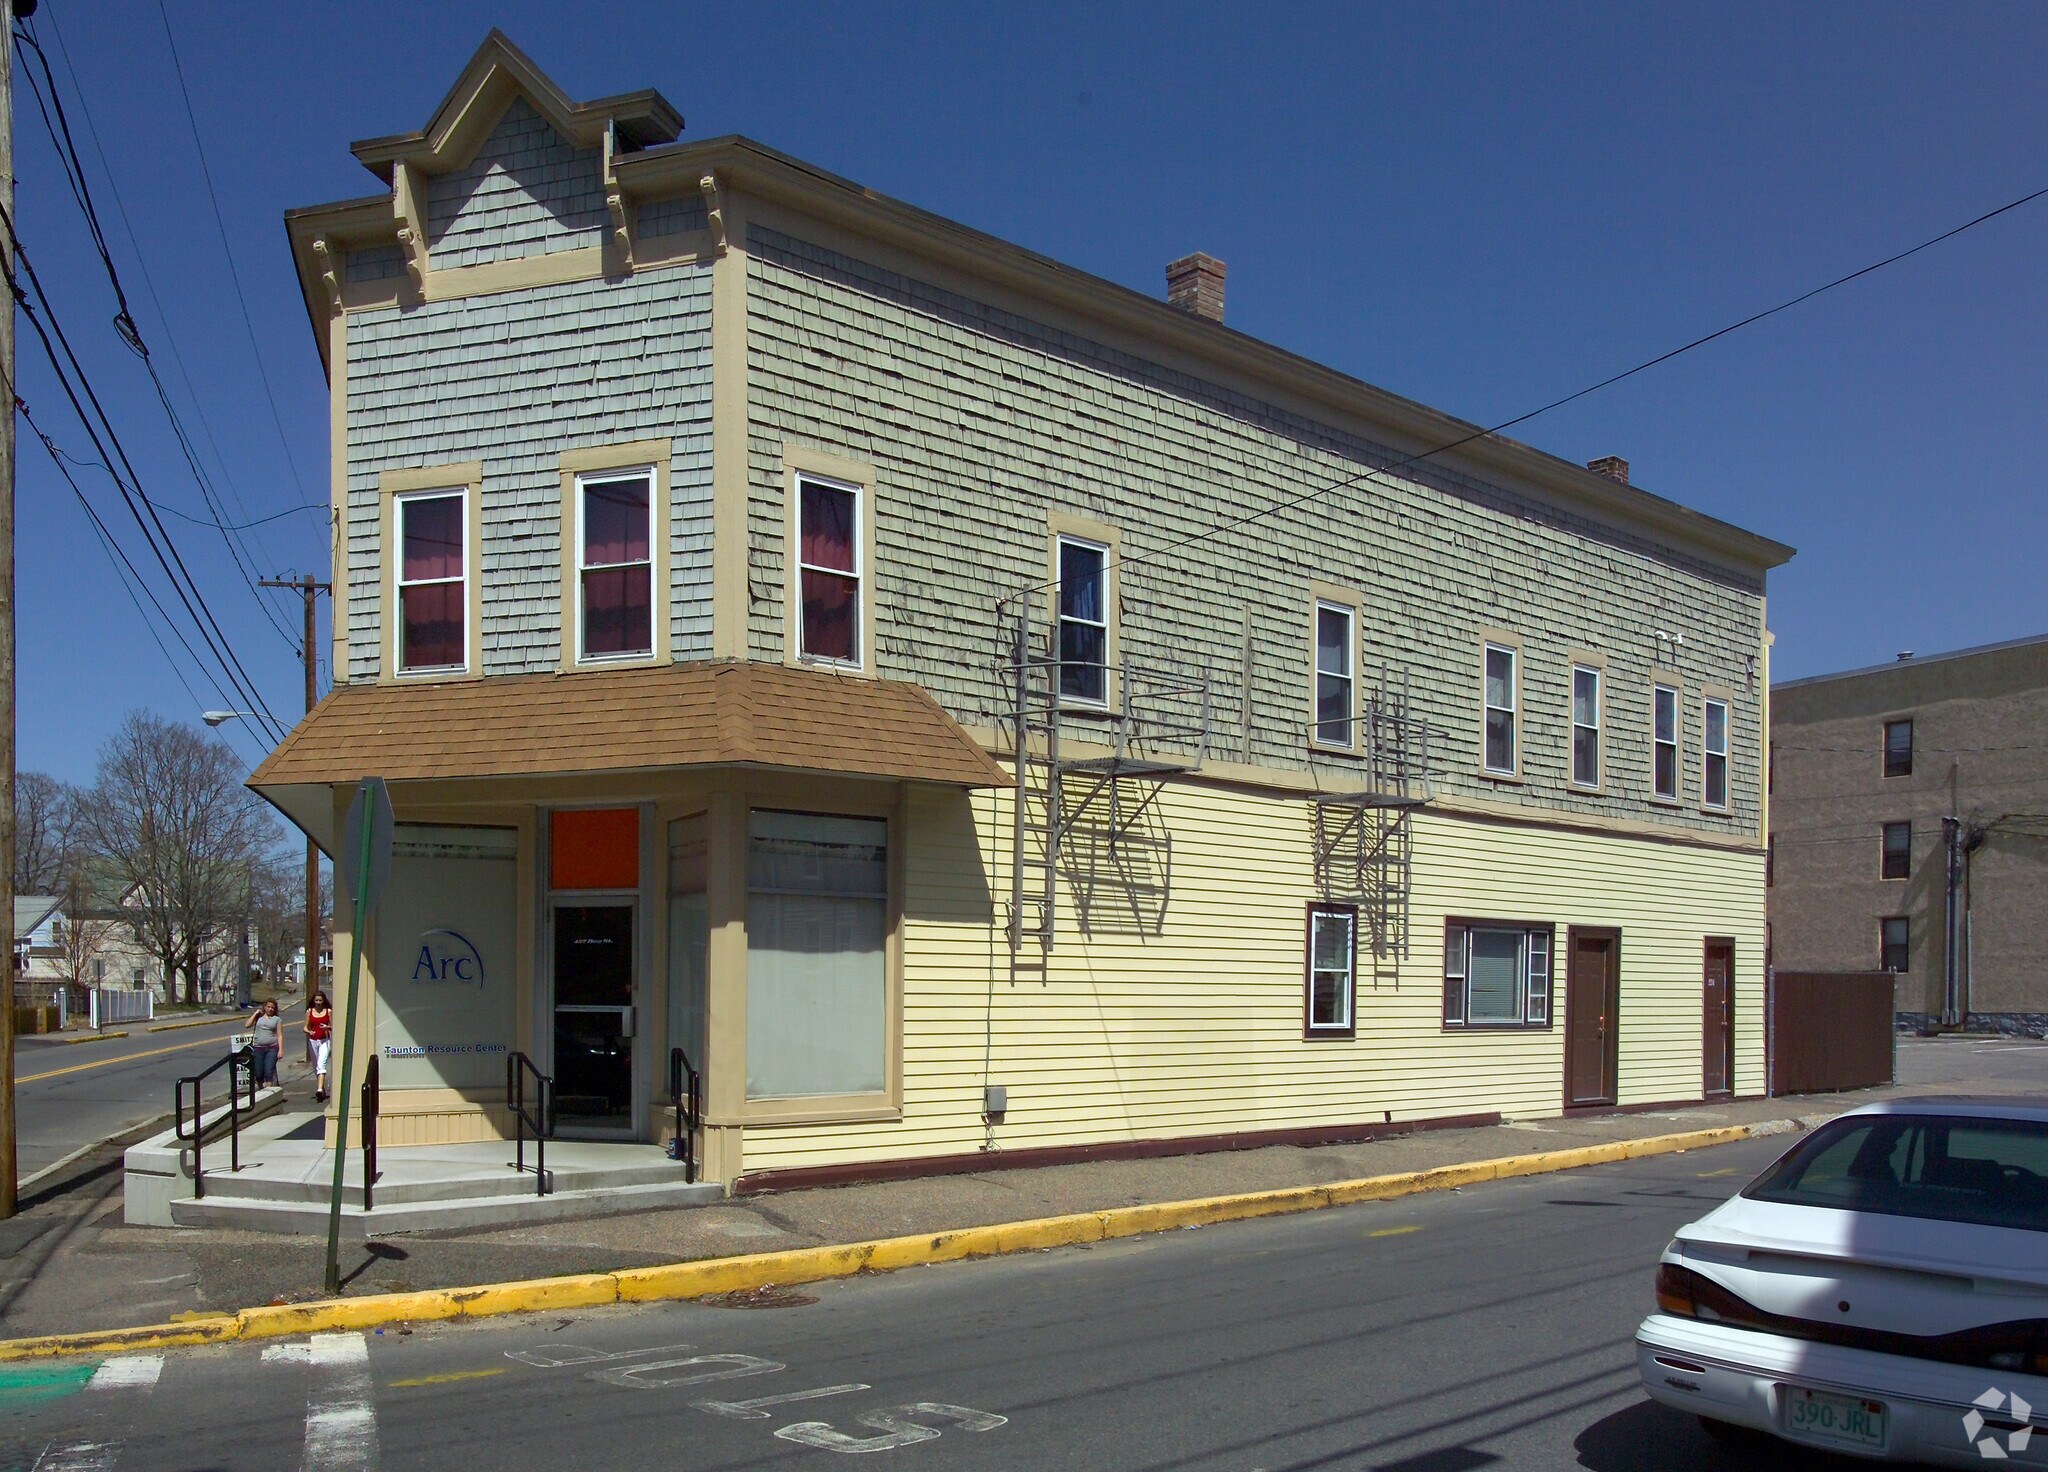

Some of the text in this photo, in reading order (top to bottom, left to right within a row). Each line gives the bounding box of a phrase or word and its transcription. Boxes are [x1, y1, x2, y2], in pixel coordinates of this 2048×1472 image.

[412, 945, 473, 980] Arc
[384, 1044, 507, 1054] Taunton Resource Center
[503, 1344, 1008, 1453] STOP
